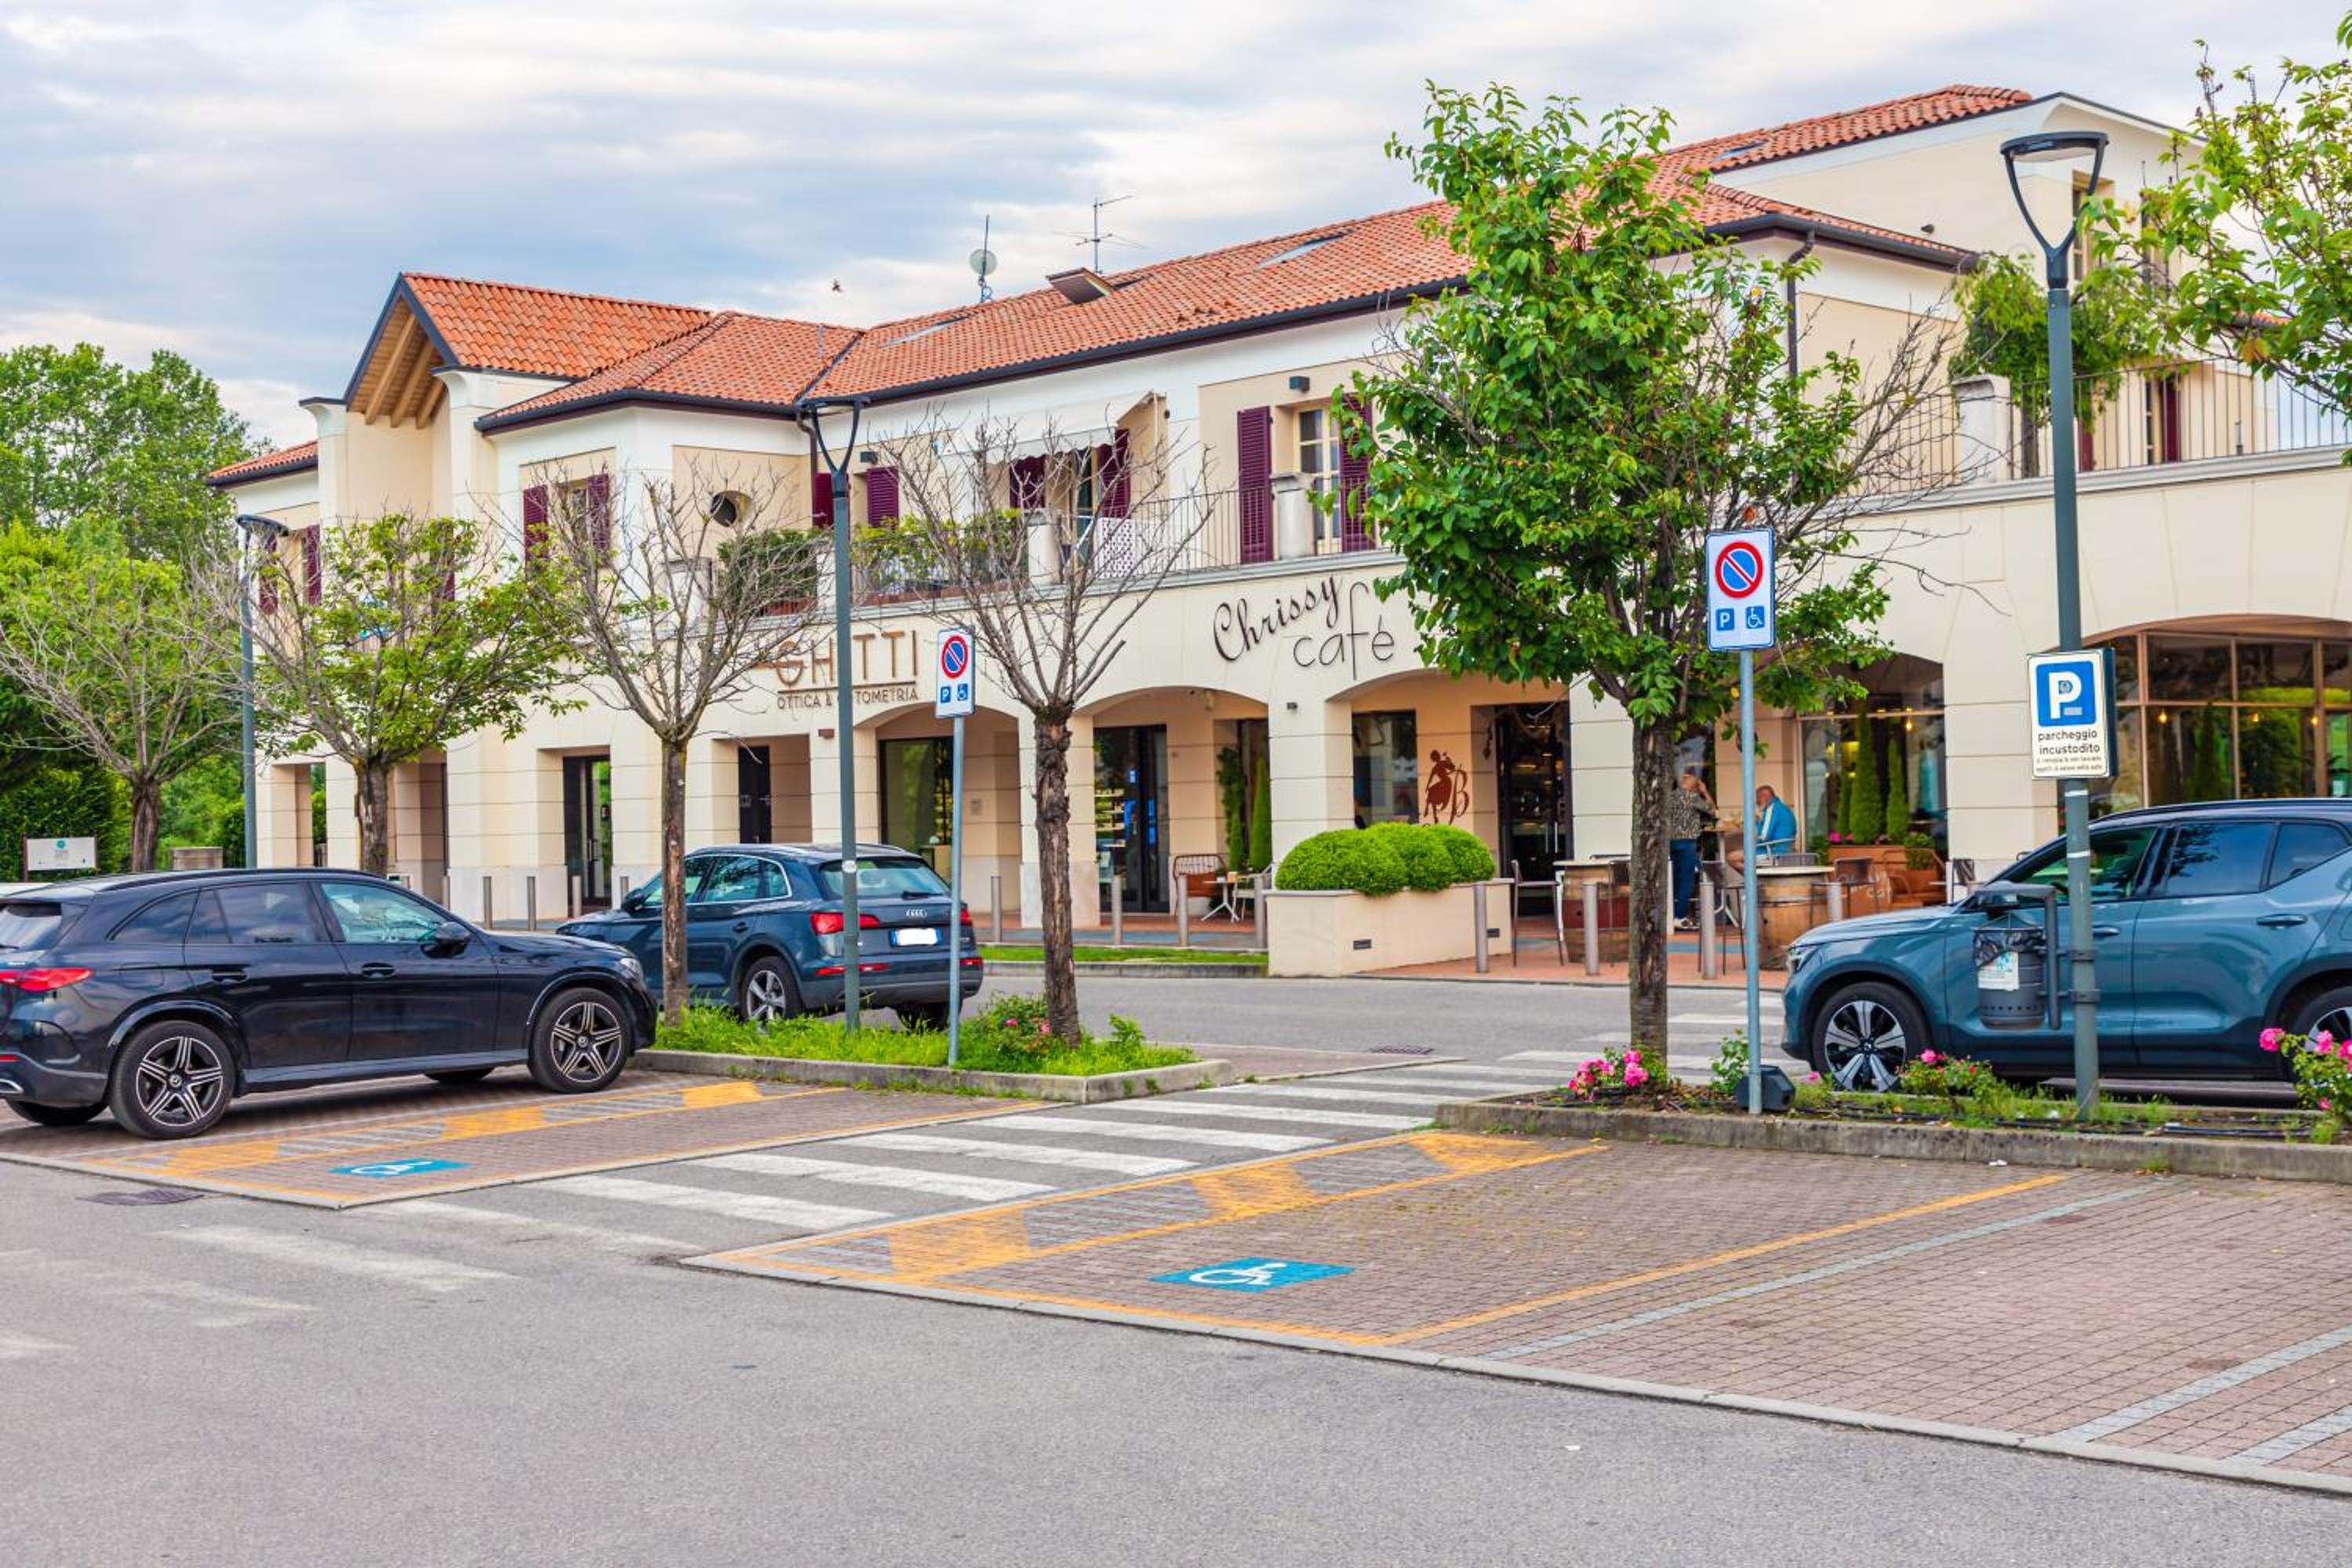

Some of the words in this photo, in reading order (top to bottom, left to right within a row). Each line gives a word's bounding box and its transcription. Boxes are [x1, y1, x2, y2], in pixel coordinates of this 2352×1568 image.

[1214, 575, 1341, 662] Chrissy
[1294, 582, 1395, 681] café
[1720, 612, 1730, 627] P
[772, 630, 918, 687] GHTTI
[778, 694, 821, 710] OTTICA
[2049, 672, 2082, 719] P
[2038, 728, 2097, 742] parcheggio
[2039, 743, 2100, 755] incustodito
